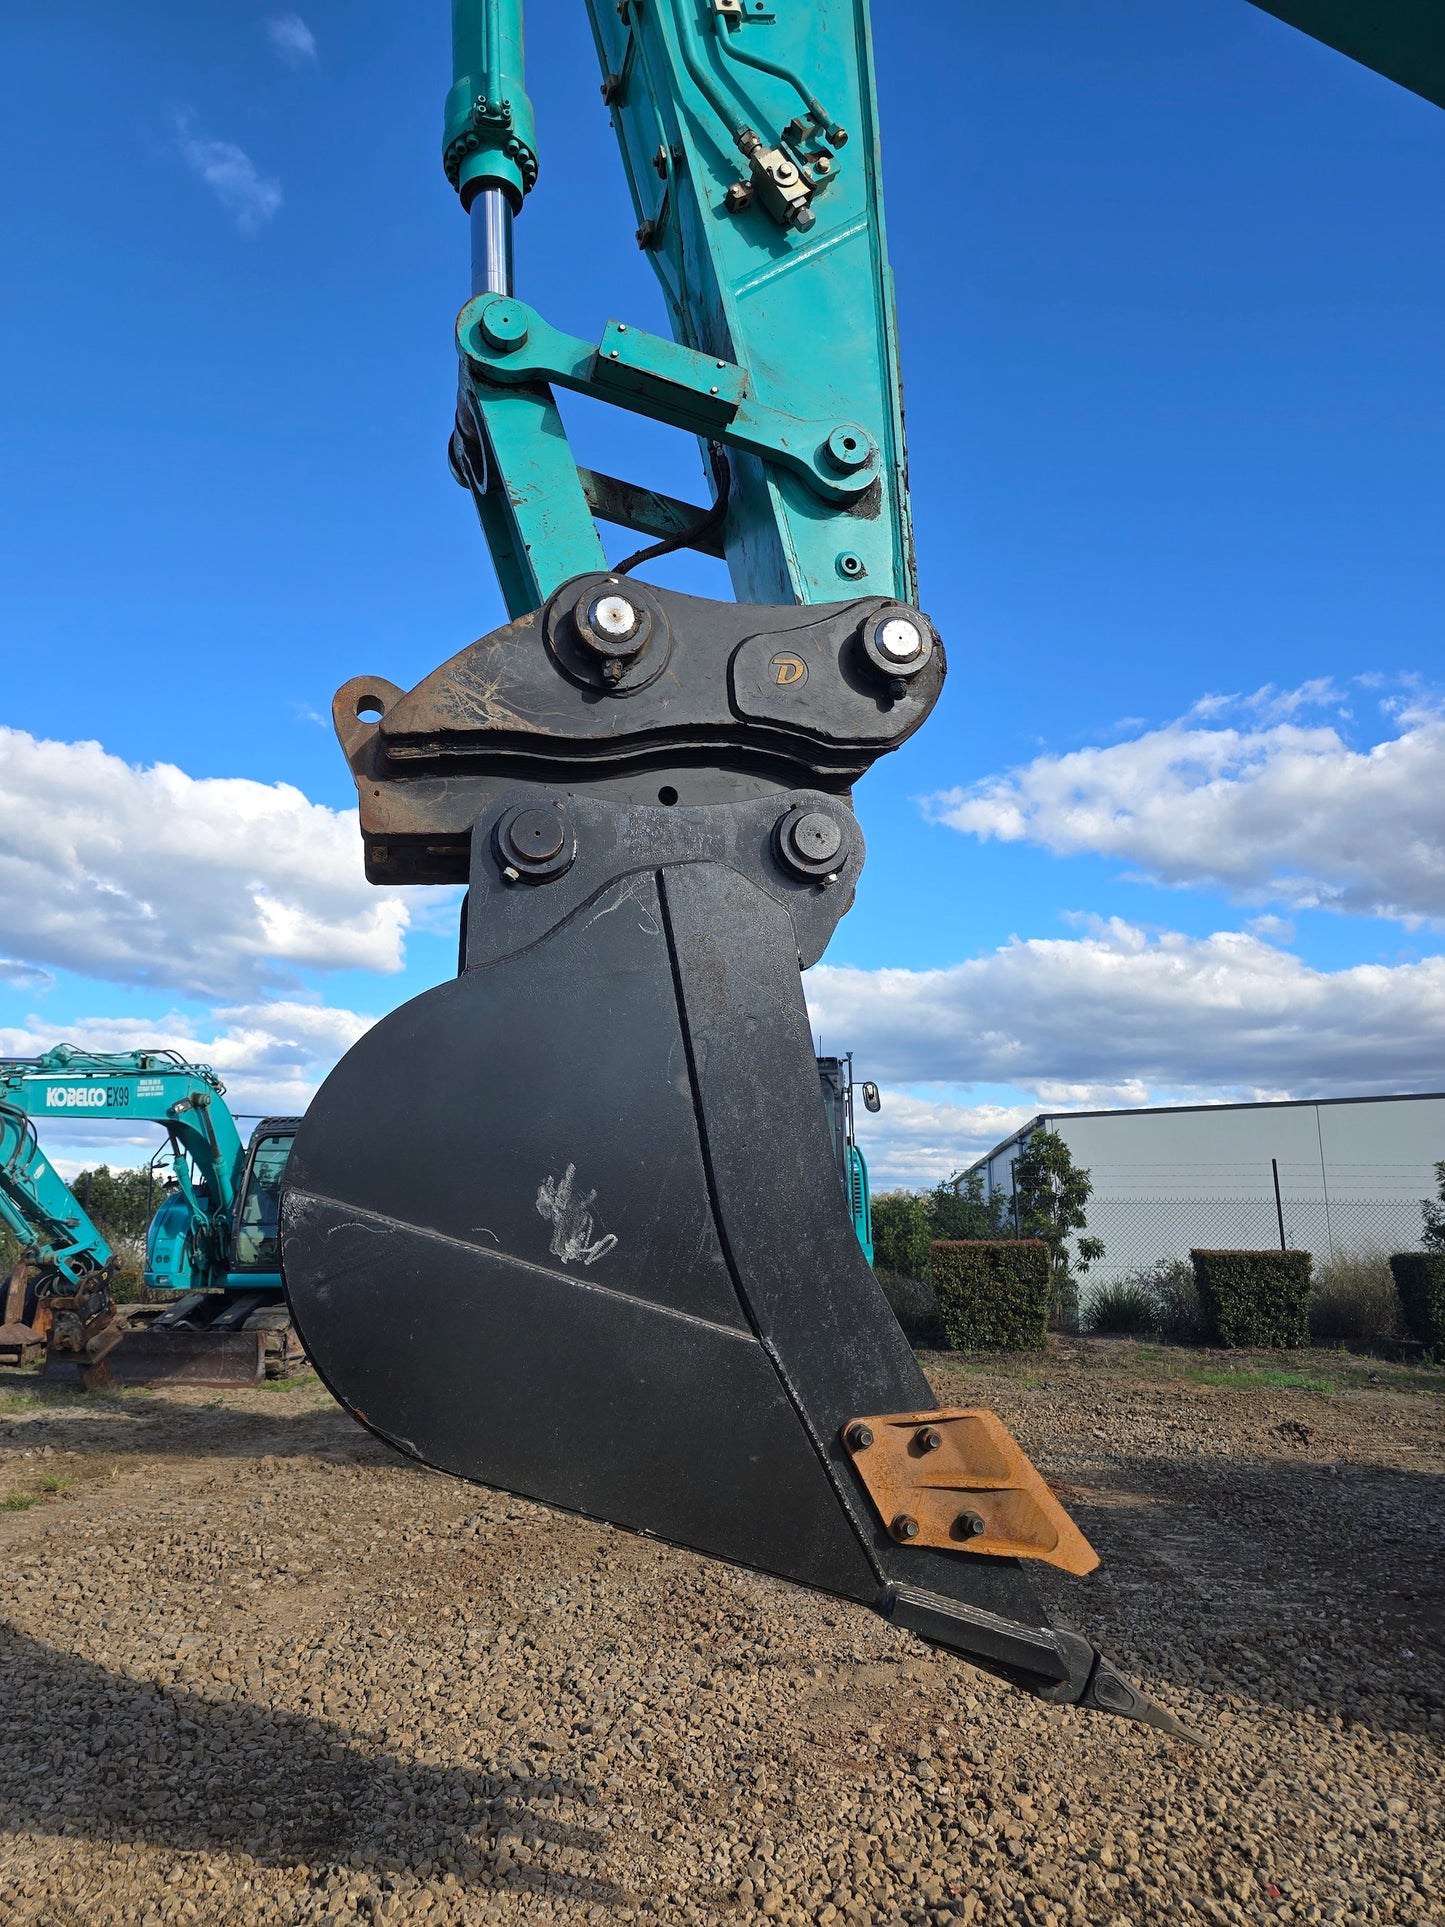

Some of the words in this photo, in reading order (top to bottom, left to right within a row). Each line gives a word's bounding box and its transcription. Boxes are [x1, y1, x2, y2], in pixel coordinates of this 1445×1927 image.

[772, 658, 804, 685] D
[46, 1087, 107, 1107] KOBELCO
[107, 1086, 129, 1107] EX99
